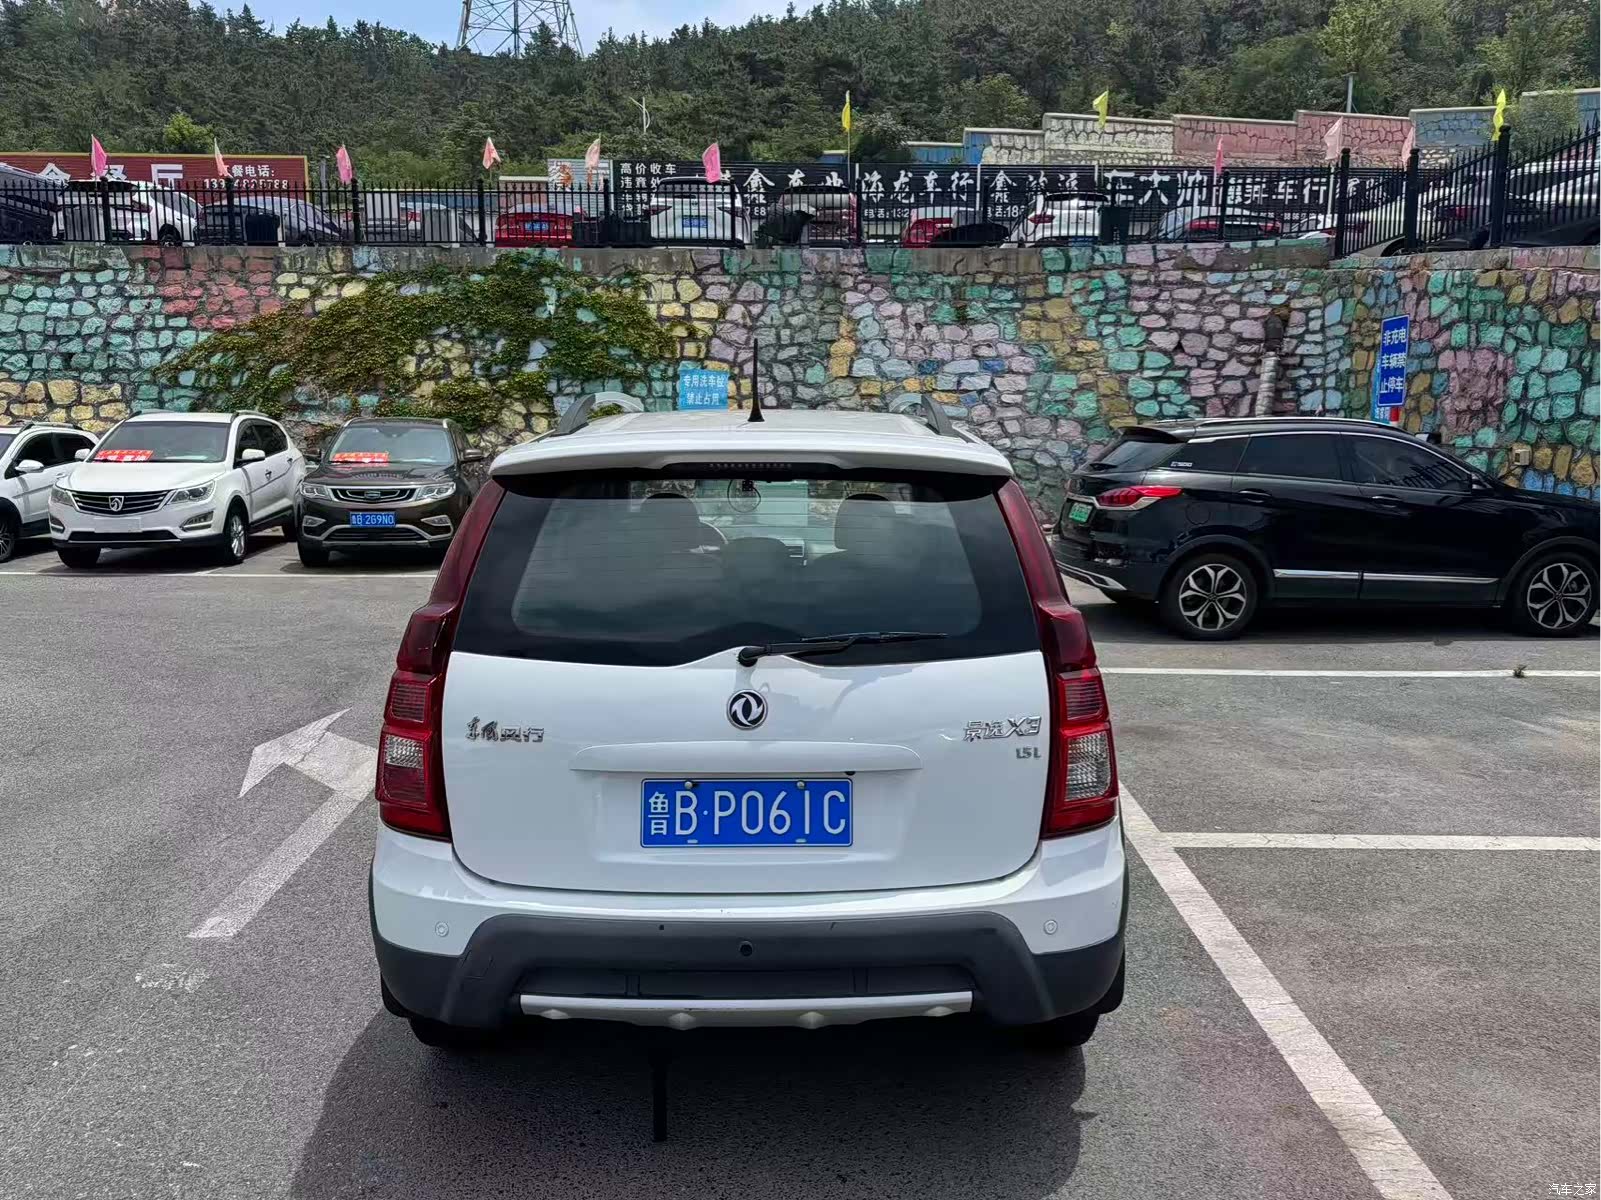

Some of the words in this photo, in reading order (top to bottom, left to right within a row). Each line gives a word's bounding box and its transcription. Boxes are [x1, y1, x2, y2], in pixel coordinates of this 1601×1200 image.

[620, 162, 677, 175] 高价收车
[1383, 328, 1406, 346] 非充电
[1379, 376, 1404, 394] 止停车
[686, 393, 720, 406] 禁止占用
